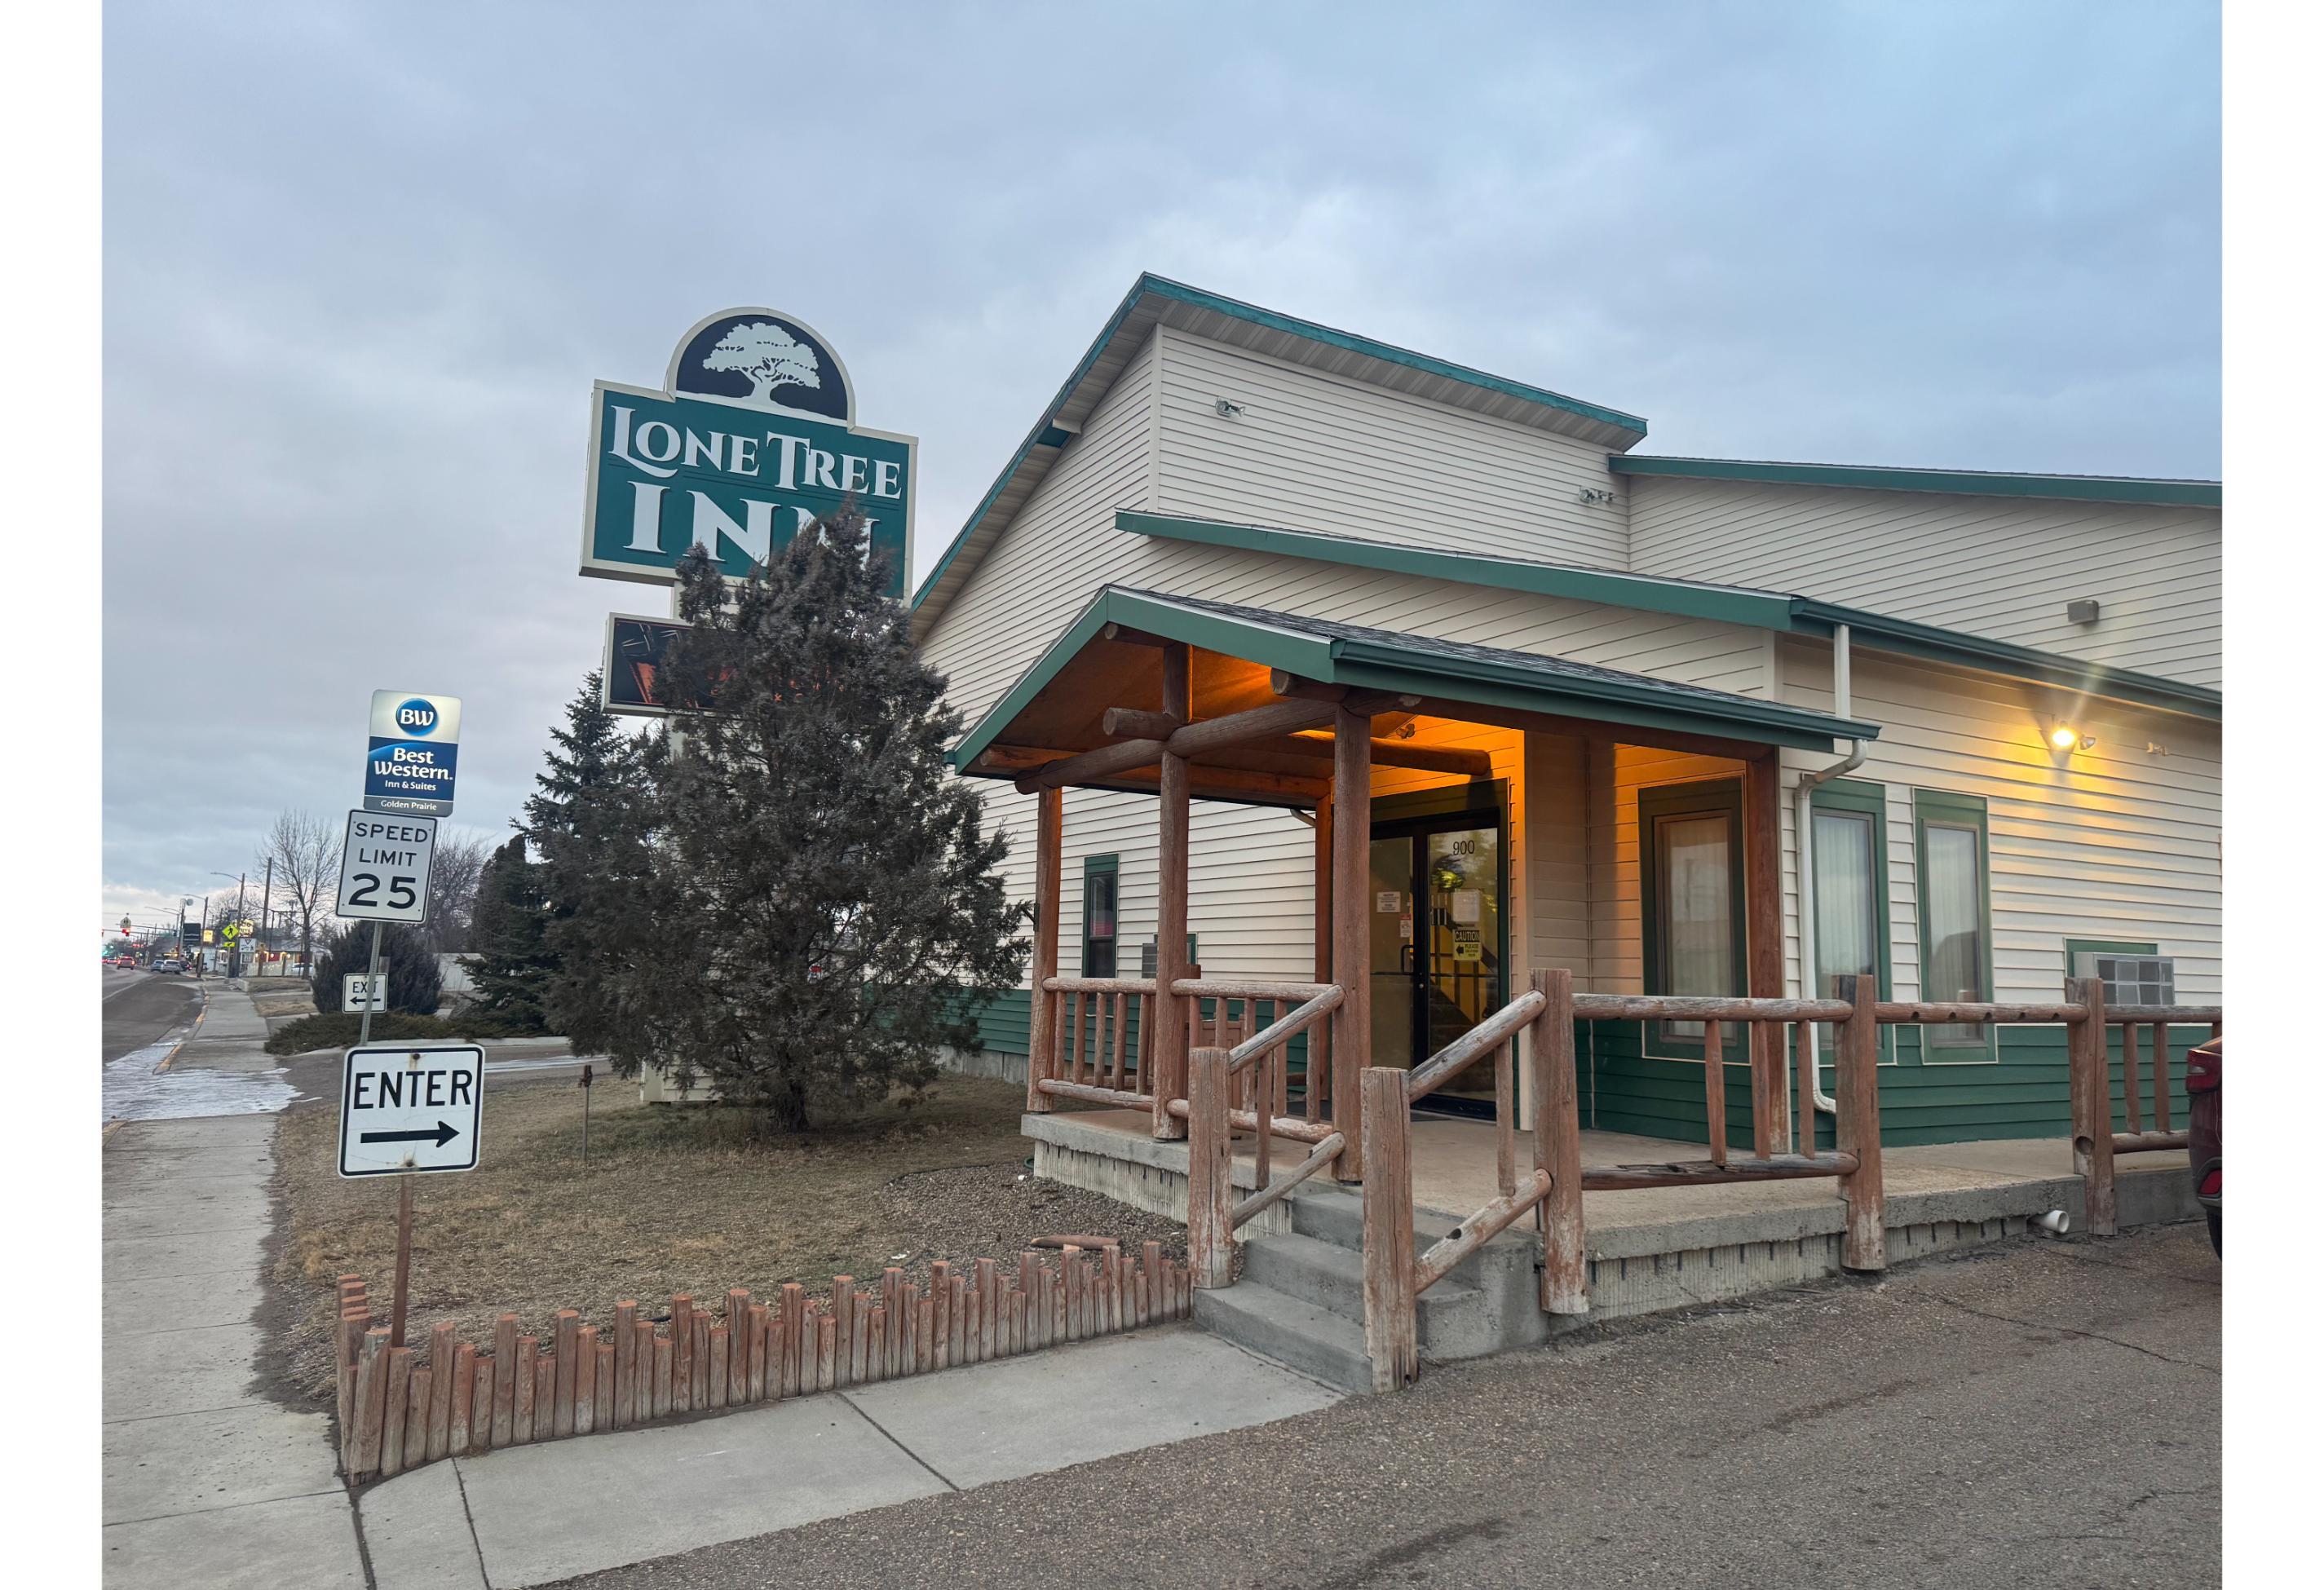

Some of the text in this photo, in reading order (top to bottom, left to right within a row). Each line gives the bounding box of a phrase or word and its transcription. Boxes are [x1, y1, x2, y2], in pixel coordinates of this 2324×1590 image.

[609, 405, 902, 499] LONE TREE
[400, 709, 434, 727] BW
[394, 748, 434, 764] Best
[385, 780, 436, 791] Inn & Suites
[381, 800, 437, 810] Golden Prairie
[354, 822, 428, 843] SPEED
[1452, 840, 1475, 855] 900
[359, 848, 417, 866] LIMIT
[348, 873, 417, 909] 25
[1455, 931, 1479, 941] CAUTION
[352, 981, 378, 993] EXT
[353, 1070, 472, 1109] ENTER
